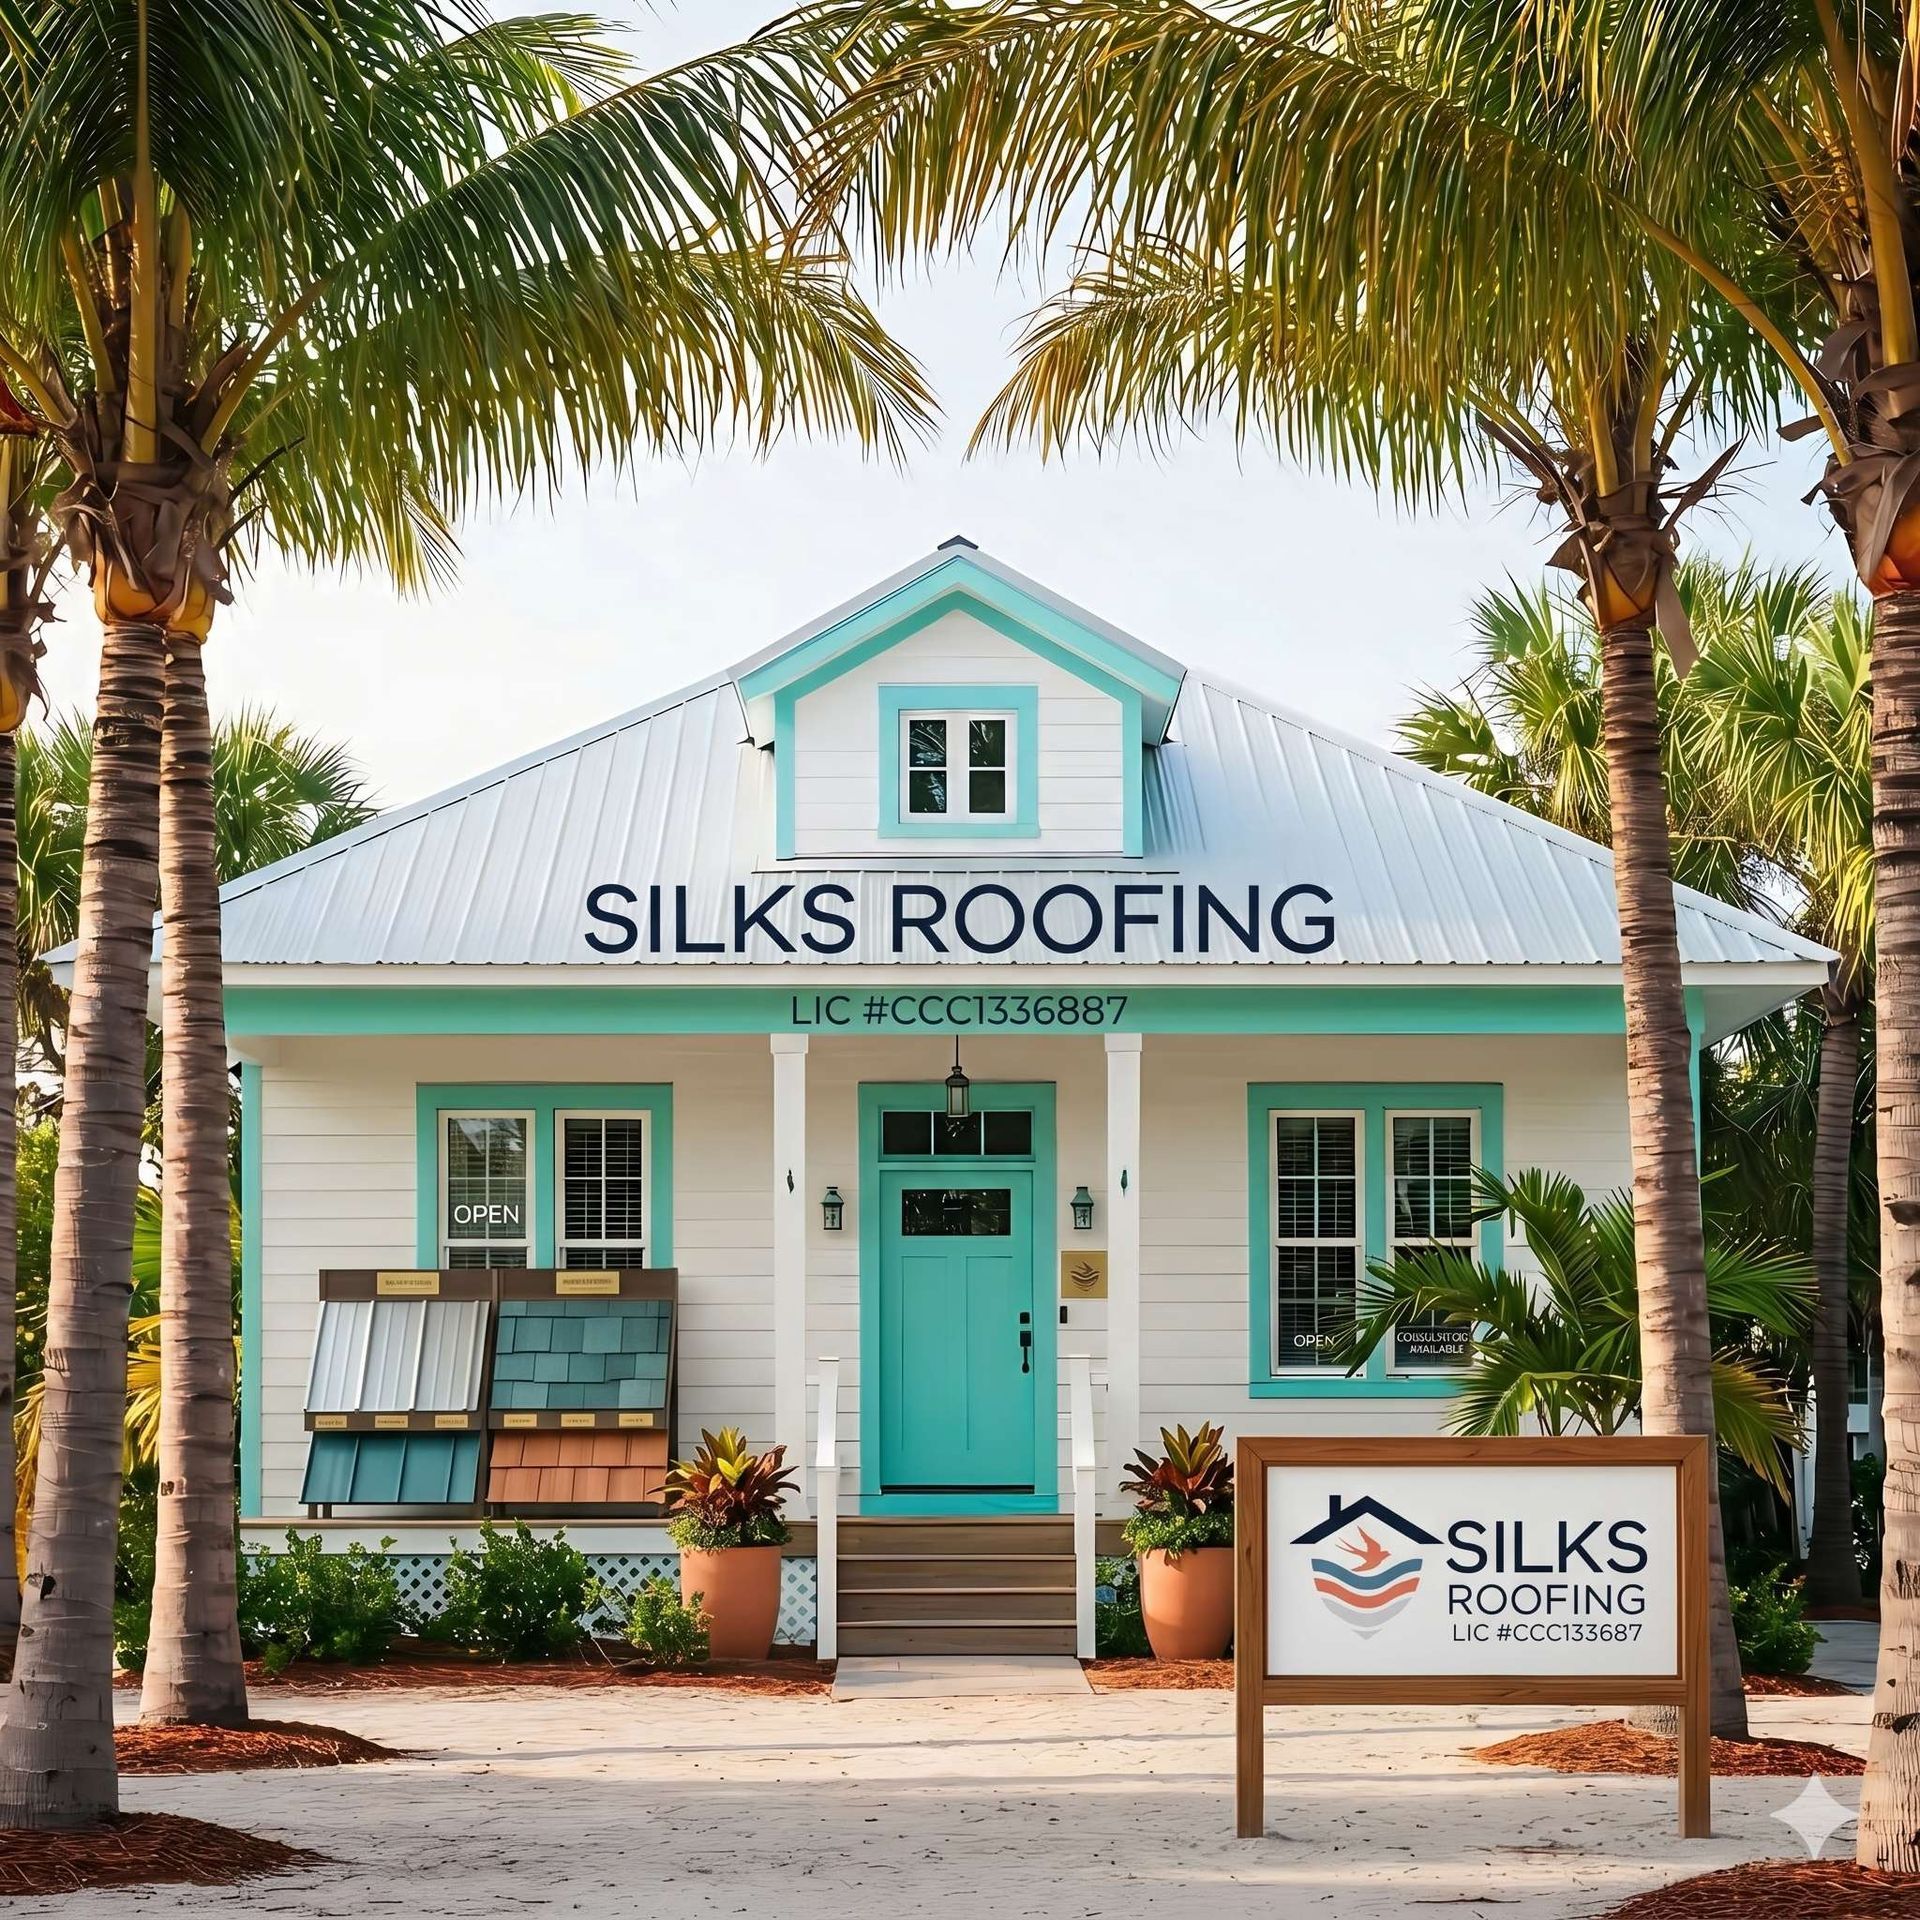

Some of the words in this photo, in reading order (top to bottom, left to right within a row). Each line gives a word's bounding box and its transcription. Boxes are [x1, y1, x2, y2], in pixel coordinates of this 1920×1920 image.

[584, 883, 856, 955] SILKS
[892, 883, 1335, 955] ROOFING
[792, 996, 851, 1025] LIC
[863, 995, 1129, 1026] #CCC1336887
[454, 1205, 520, 1224] OPEN
[1293, 1334, 1335, 1347] OPEN
[1447, 1520, 1648, 1574] SILKS
[1448, 1583, 1645, 1616] ROOFING
[1453, 1623, 1489, 1642] LIC
[1496, 1623, 1643, 1642] #CCC133687
